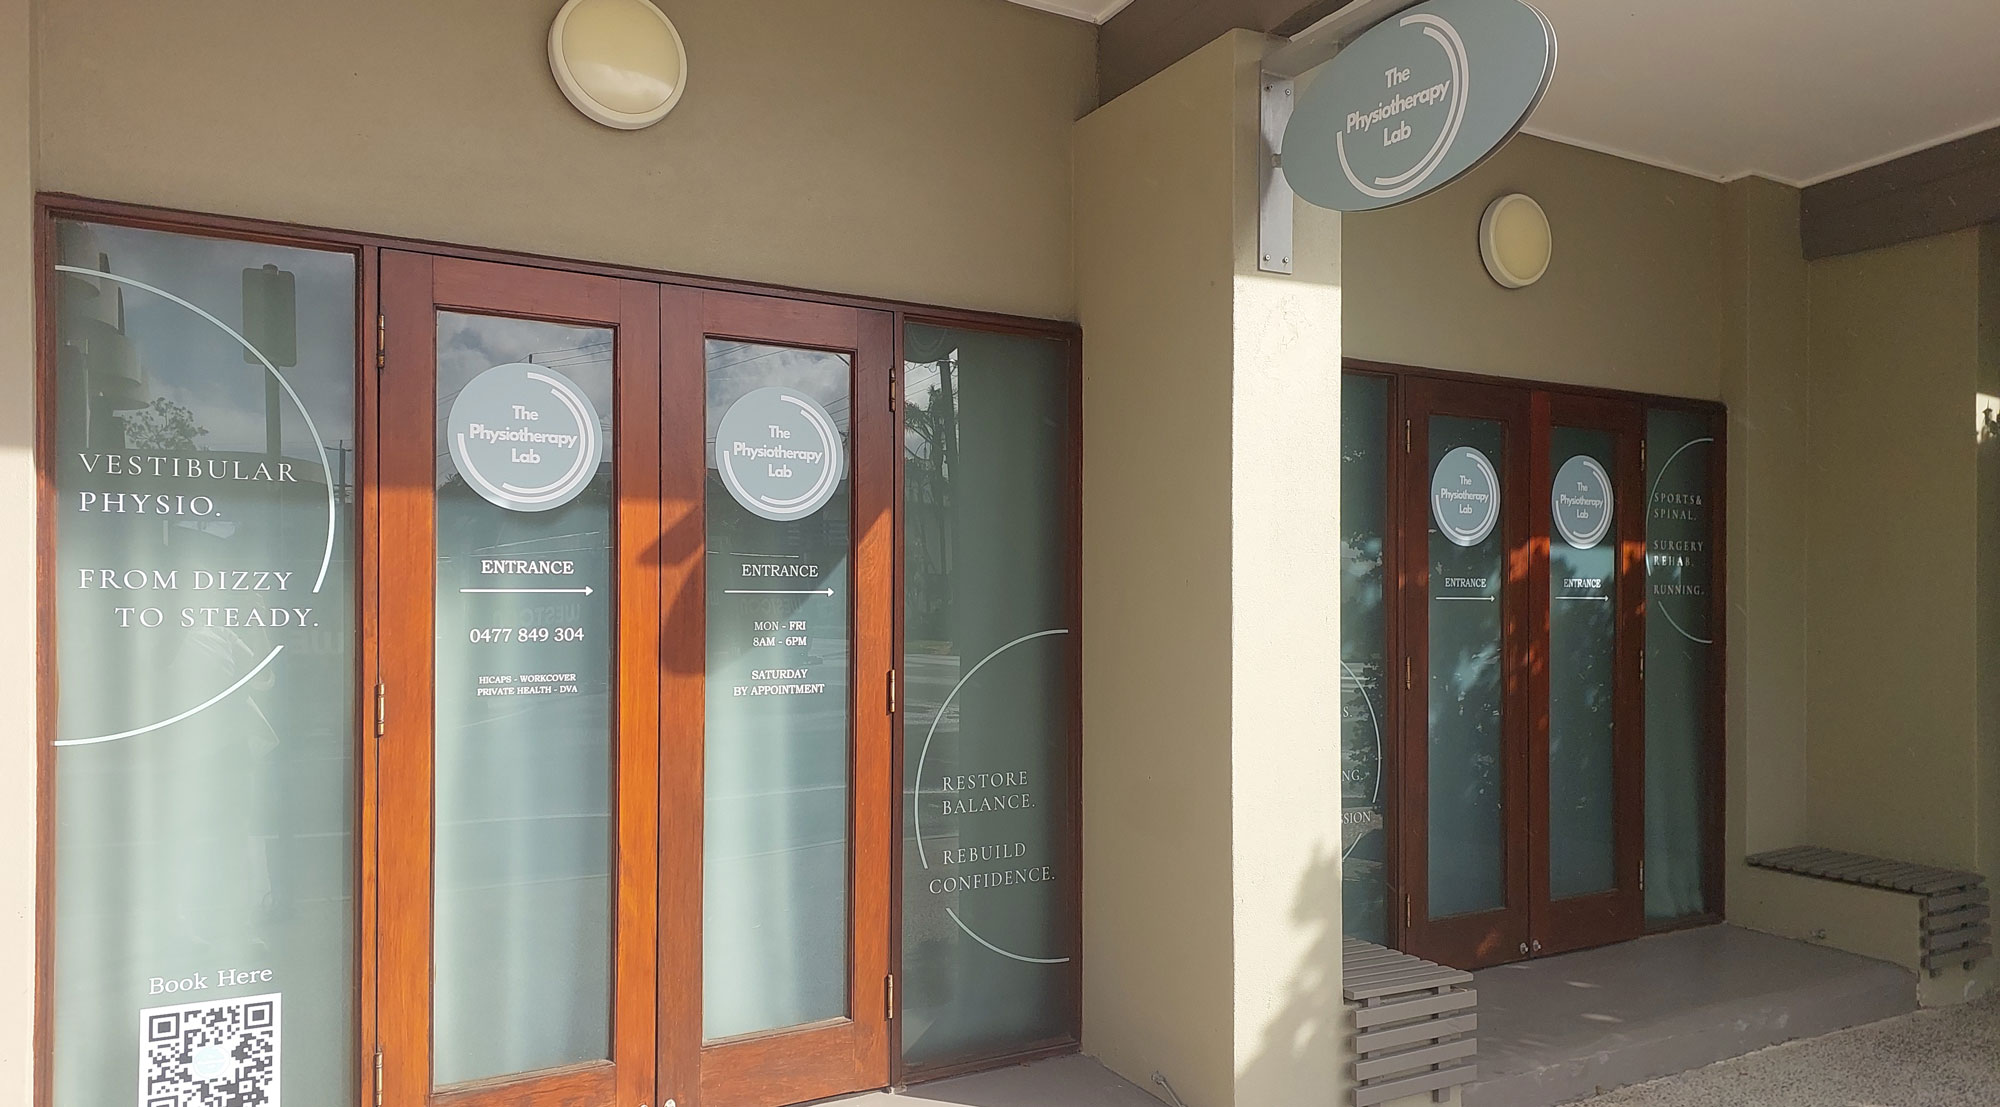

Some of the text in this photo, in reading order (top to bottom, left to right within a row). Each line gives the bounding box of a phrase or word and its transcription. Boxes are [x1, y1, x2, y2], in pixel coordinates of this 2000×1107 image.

[1384, 66, 1411, 88] The
[1346, 80, 1450, 134] Physiotherapy
[1383, 120, 1412, 147] Lab
[512, 405, 539, 420] The
[469, 423, 578, 449] Physiotherapy
[769, 425, 791, 439] The
[511, 448, 541, 464] Lab
[733, 441, 822, 464] Physiotherapy
[78, 453, 298, 483] VESTIBULAR
[768, 464, 793, 478] Lab
[1459, 475, 1472, 486] The
[1576, 482, 1589, 492] The
[1440, 488, 1489, 504] Physiotherapy
[1560, 494, 1603, 509] Physiotherapy
[78, 491, 221, 517] PHYSIO.
[1459, 504, 1473, 515] Lab
[1576, 509, 1589, 519] Lab
[1653, 508, 1697, 521] SPINAL.
[1653, 540, 1704, 552] SURGERY
[481, 559, 575, 575] ENTRANCE
[742, 564, 819, 577] ENTRANCE
[78, 568, 293, 591] FROM DIZZY
[1445, 577, 1487, 588] ENTRANCE
[1563, 578, 1602, 588] ENTRANCE
[1653, 584, 1705, 595] RUNNING.
[115, 607, 319, 628] TO STEADY.
[754, 621, 779, 631] MON
[789, 621, 806, 631] FRI
[469, 627, 584, 643] 0477 849 304
[753, 637, 775, 647] 8AM
[785, 636, 807, 646] 6PM
[478, 675, 512, 685] HICAPS
[520, 674, 576, 683] WORKCOVER
[751, 669, 808, 680] SATURDAY
[477, 686, 515, 696] PRIVATE
[517, 686, 552, 695] HEALTH
[559, 685, 578, 694] DVA
[733, 684, 825, 697] BY APPOINTMENT
[942, 770, 1029, 792] RESTORE
[942, 793, 1036, 816] BALANCE.
[943, 842, 1026, 865] REBUILD
[929, 866, 1055, 894] CONFIDENCE.
[148, 968, 273, 995] Book Here
